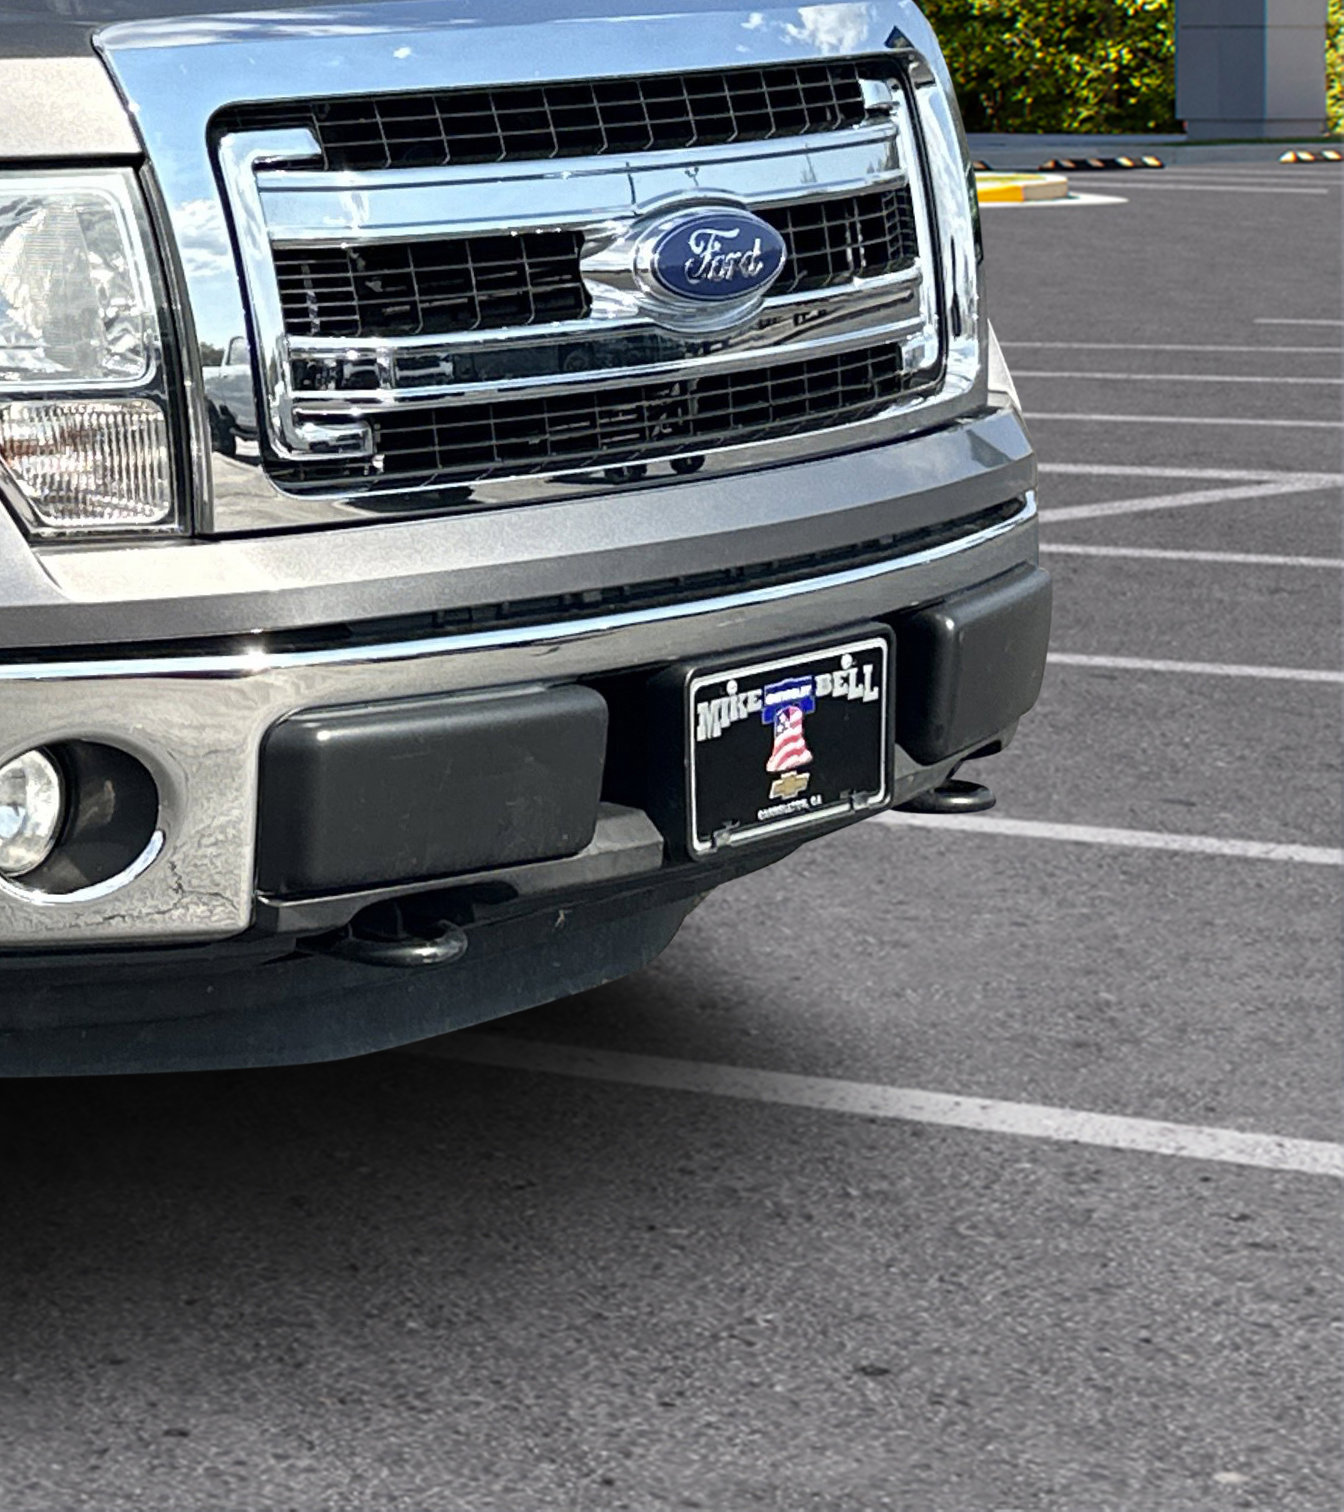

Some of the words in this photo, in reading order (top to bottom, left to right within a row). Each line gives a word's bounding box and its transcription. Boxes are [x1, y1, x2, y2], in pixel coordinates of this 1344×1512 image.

[684, 227, 765, 285] Ford
[696, 688, 762, 742] MIKE
[815, 663, 879, 703] BELL
